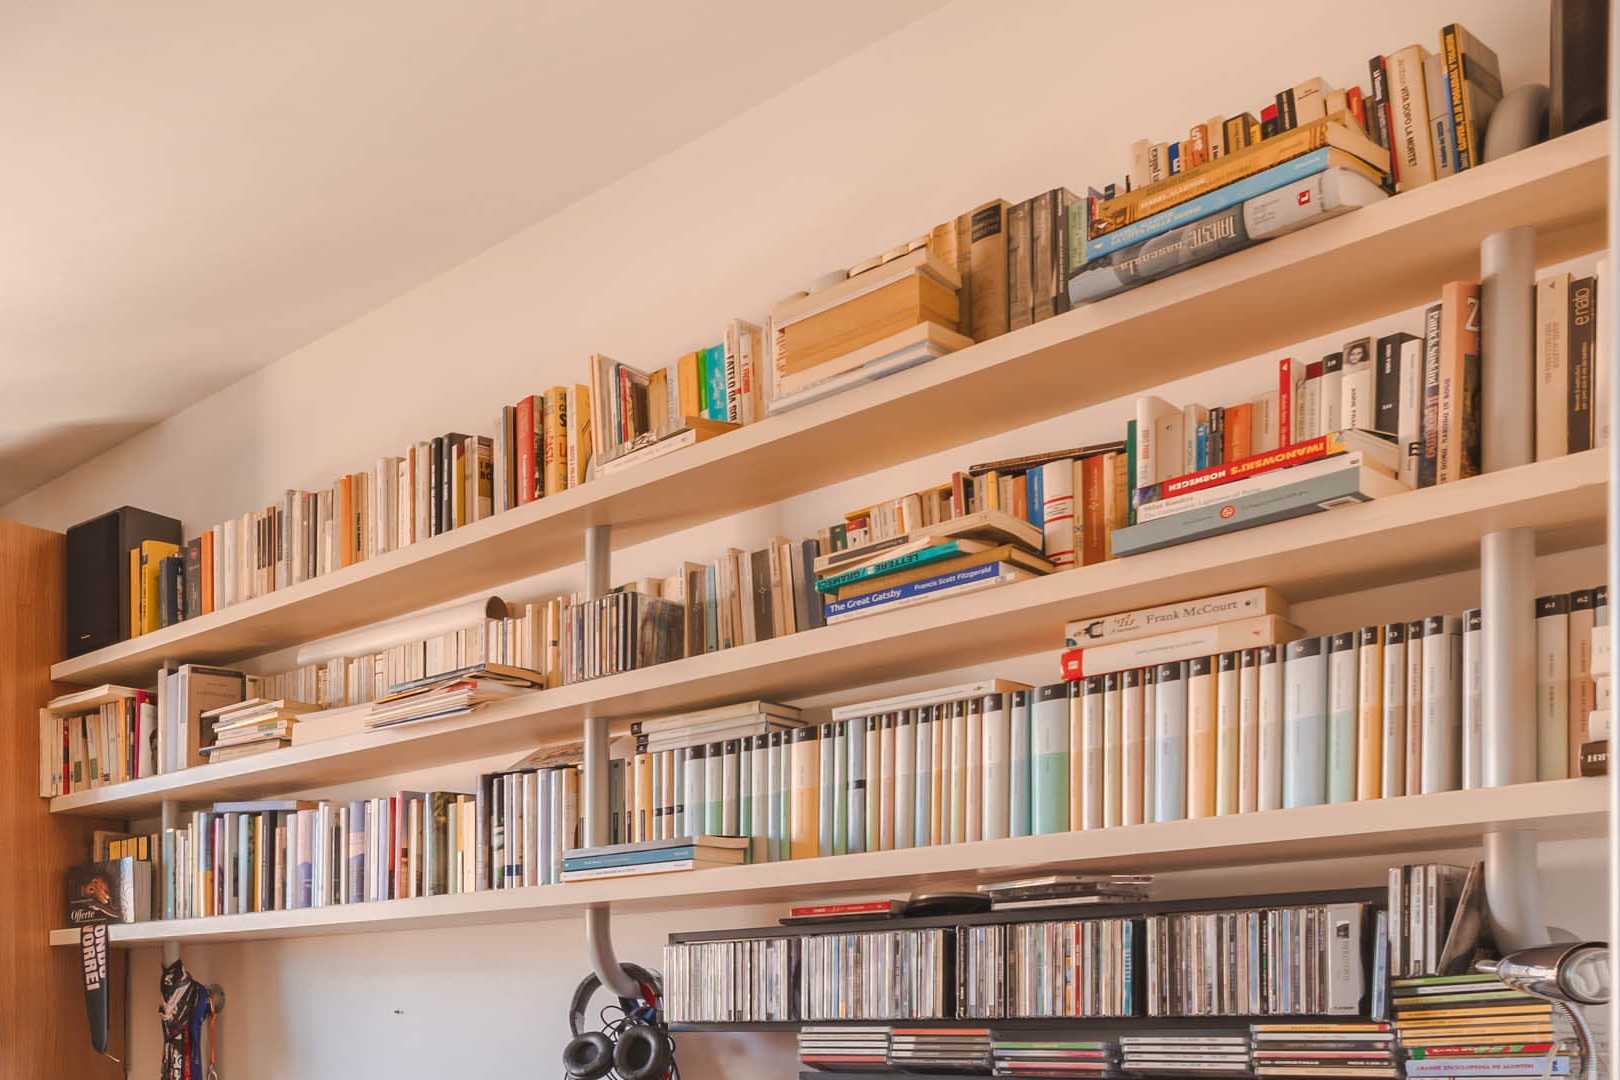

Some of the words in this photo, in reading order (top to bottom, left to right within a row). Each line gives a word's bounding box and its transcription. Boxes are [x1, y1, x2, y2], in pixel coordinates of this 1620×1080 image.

[1400, 86, 1411, 102] VITA
[1403, 104, 1413, 125] DOPO
[1408, 138, 1418, 167] MORTE?
[1190, 215, 1237, 249] TRIESTE
[1427, 310, 1440, 347] Patrick
[1230, 442, 1325, 476] IWANOWSKI'S
[1168, 469, 1227, 492] NORWEGEN
[875, 553, 919, 573] LETTERE
[817, 571, 861, 589] GRAMSCI
[829, 602, 846, 614] The
[846, 595, 870, 610] Great
[871, 588, 902, 603] Gatsby
[914, 578, 938, 592] Francis
[938, 573, 957, 586] Scott
[957, 565, 993, 582] Fitzgerald
[1146, 610, 1181, 625] Frank
[1182, 600, 1239, 618] McCourt
[70, 909, 96, 921] Offerte
